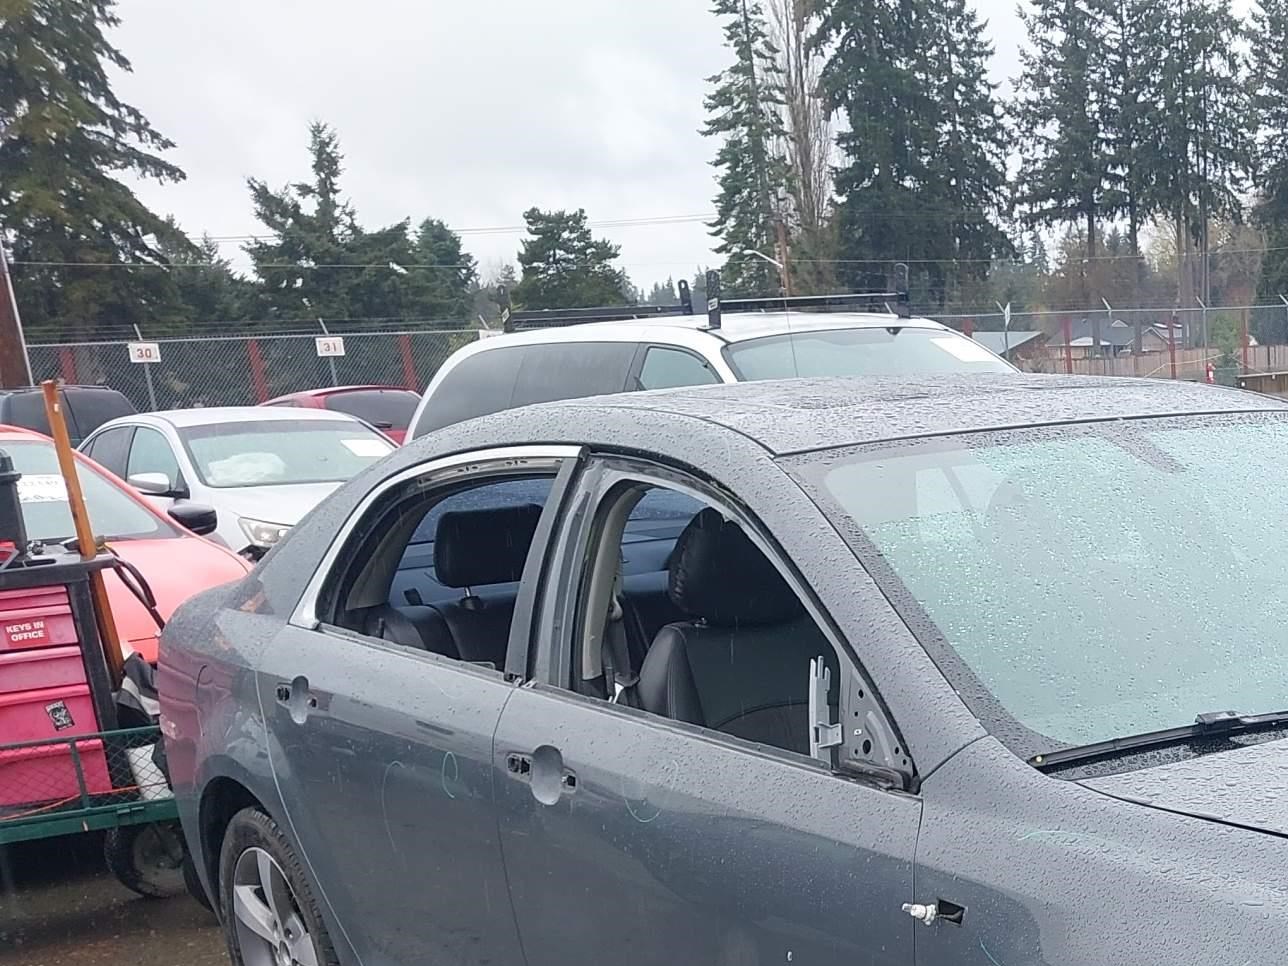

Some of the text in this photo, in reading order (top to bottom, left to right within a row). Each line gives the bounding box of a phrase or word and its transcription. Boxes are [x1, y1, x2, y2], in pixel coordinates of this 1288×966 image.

[323, 342, 337, 353] 31
[136, 348, 153, 359] 30
[6, 621, 44, 633] KEYS IN
[11, 630, 45, 642] OFFICE
